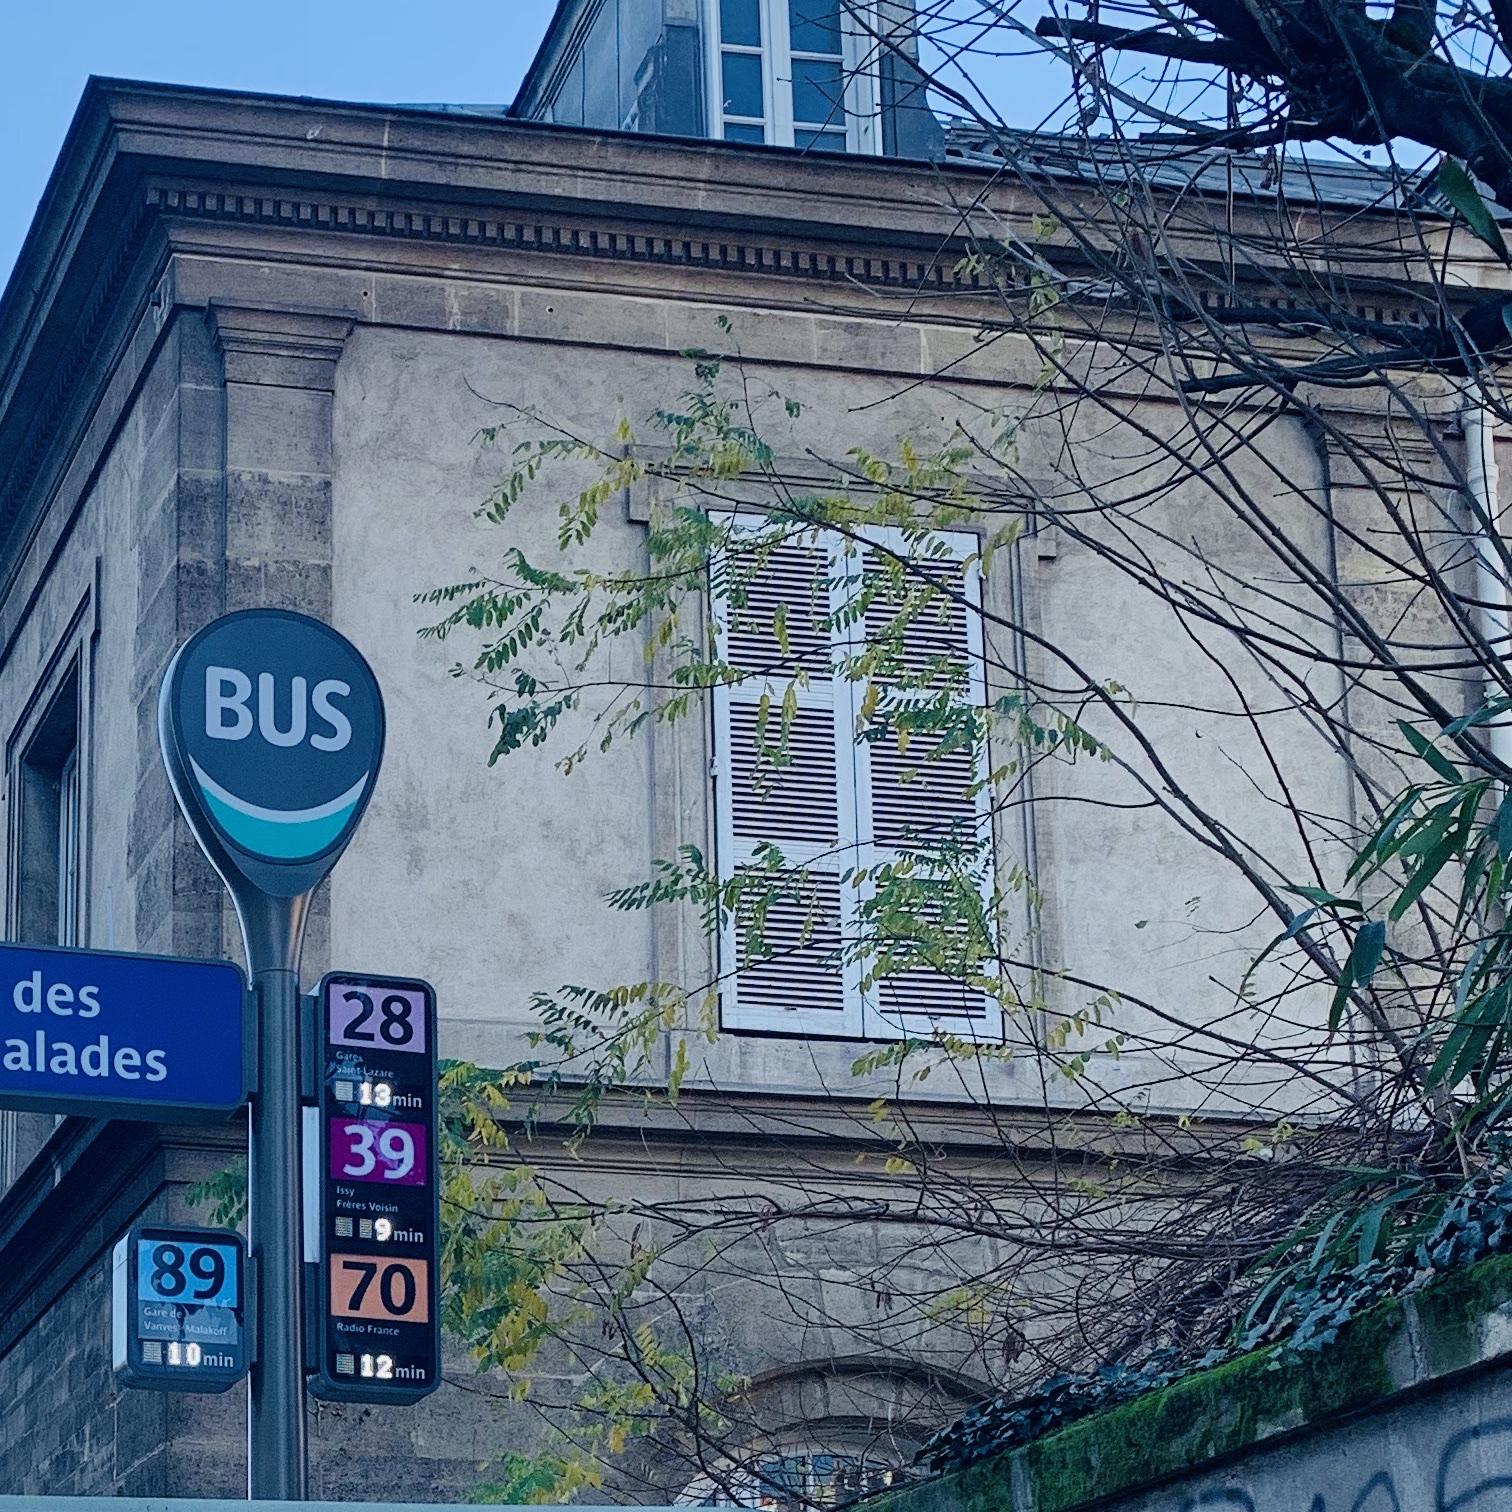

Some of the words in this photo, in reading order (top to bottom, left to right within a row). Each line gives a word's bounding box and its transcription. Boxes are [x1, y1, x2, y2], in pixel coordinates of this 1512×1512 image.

[205, 665, 352, 752] BUS
[12, 970, 102, 1019] des
[342, 990, 414, 1046] 28
[342, 1123, 415, 1180] 39
[336, 1185, 355, 1198] Issy
[369, 1201, 399, 1213] Voisin
[150, 1243, 226, 1300] 89
[342, 1260, 416, 1316] 70
[143, 1306, 168, 1318] Gare
[169, 1307, 183, 1319] de
[336, 1322, 365, 1333] Radio
[368, 1324, 400, 1336] France
